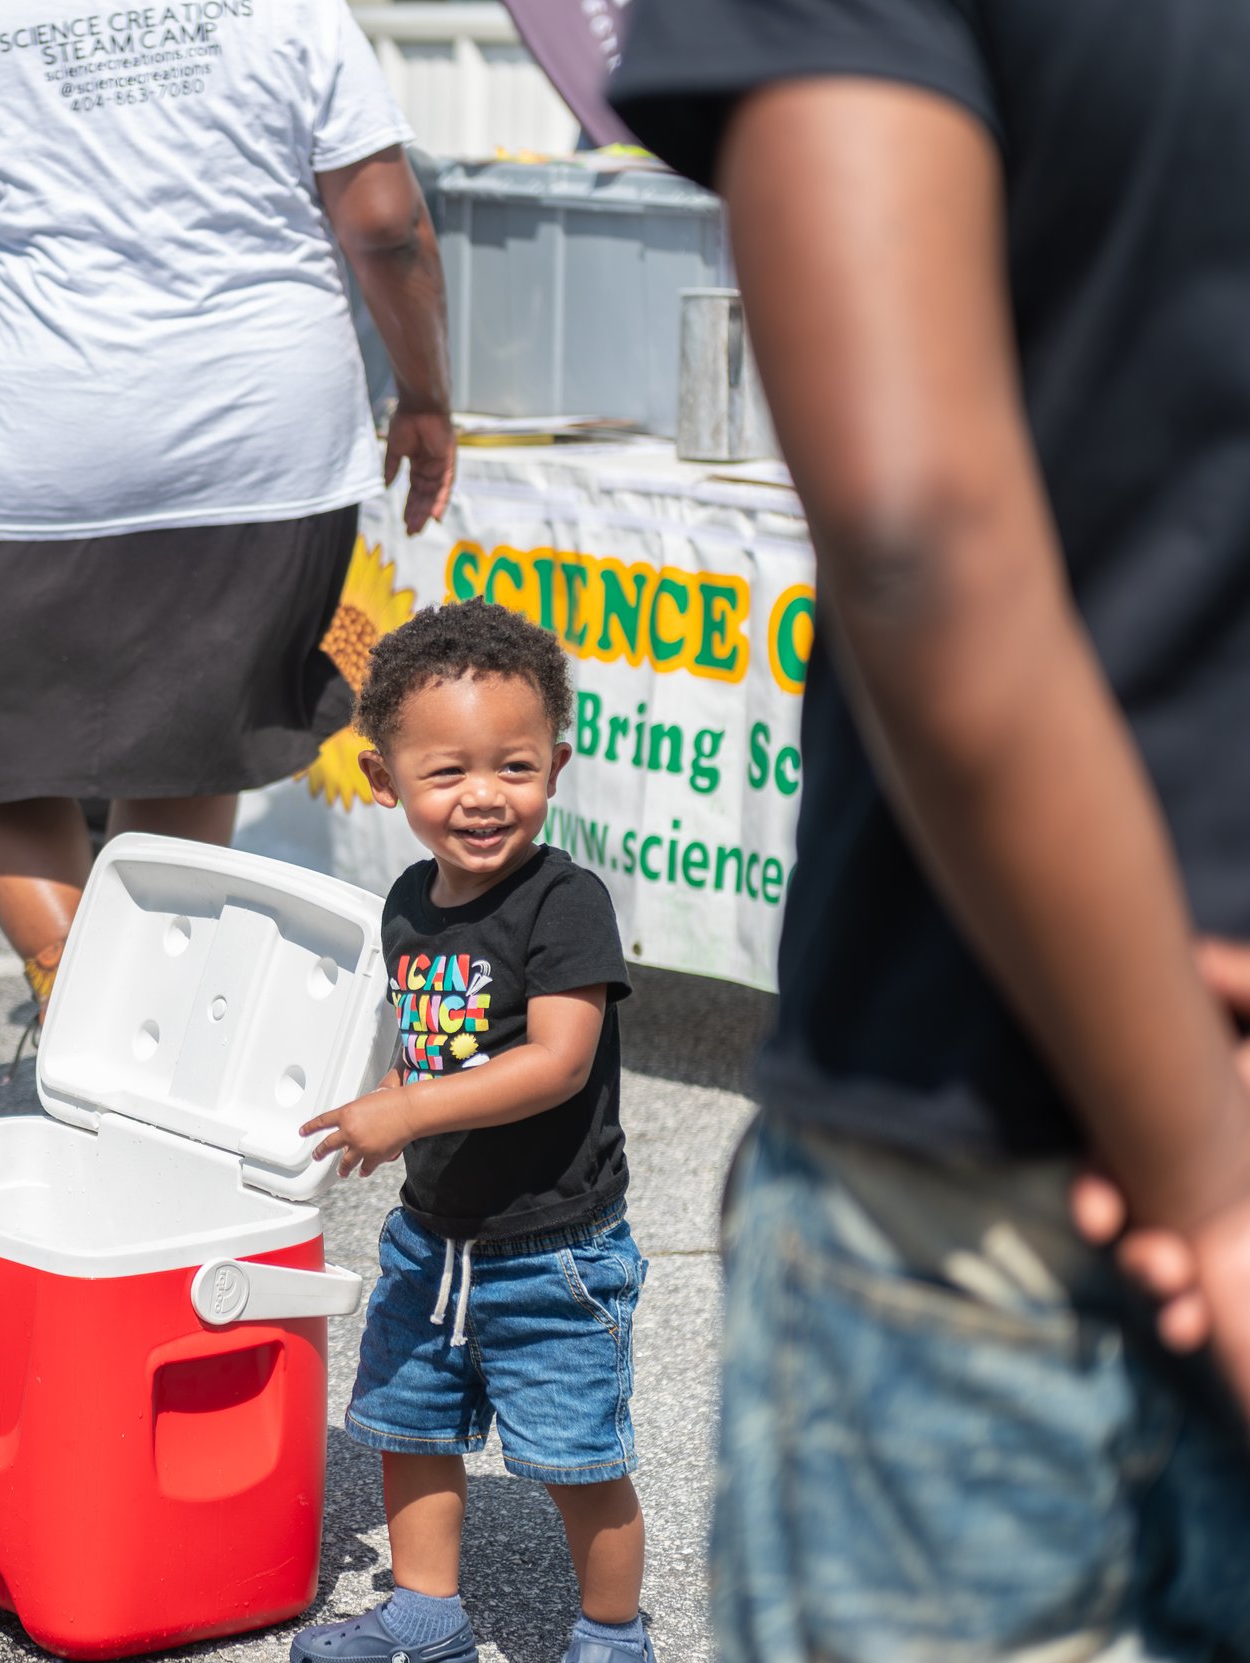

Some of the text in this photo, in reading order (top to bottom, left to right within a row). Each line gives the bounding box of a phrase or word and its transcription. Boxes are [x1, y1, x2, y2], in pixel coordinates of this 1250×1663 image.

[107, 0, 254, 33] CREATIONS
[41, 21, 218, 66] STEAM CAMP
[44, 42, 223, 82] sciencecreations.com
[60, 64, 213, 98] @sciencecreations
[576, 690, 726, 794] Bring
